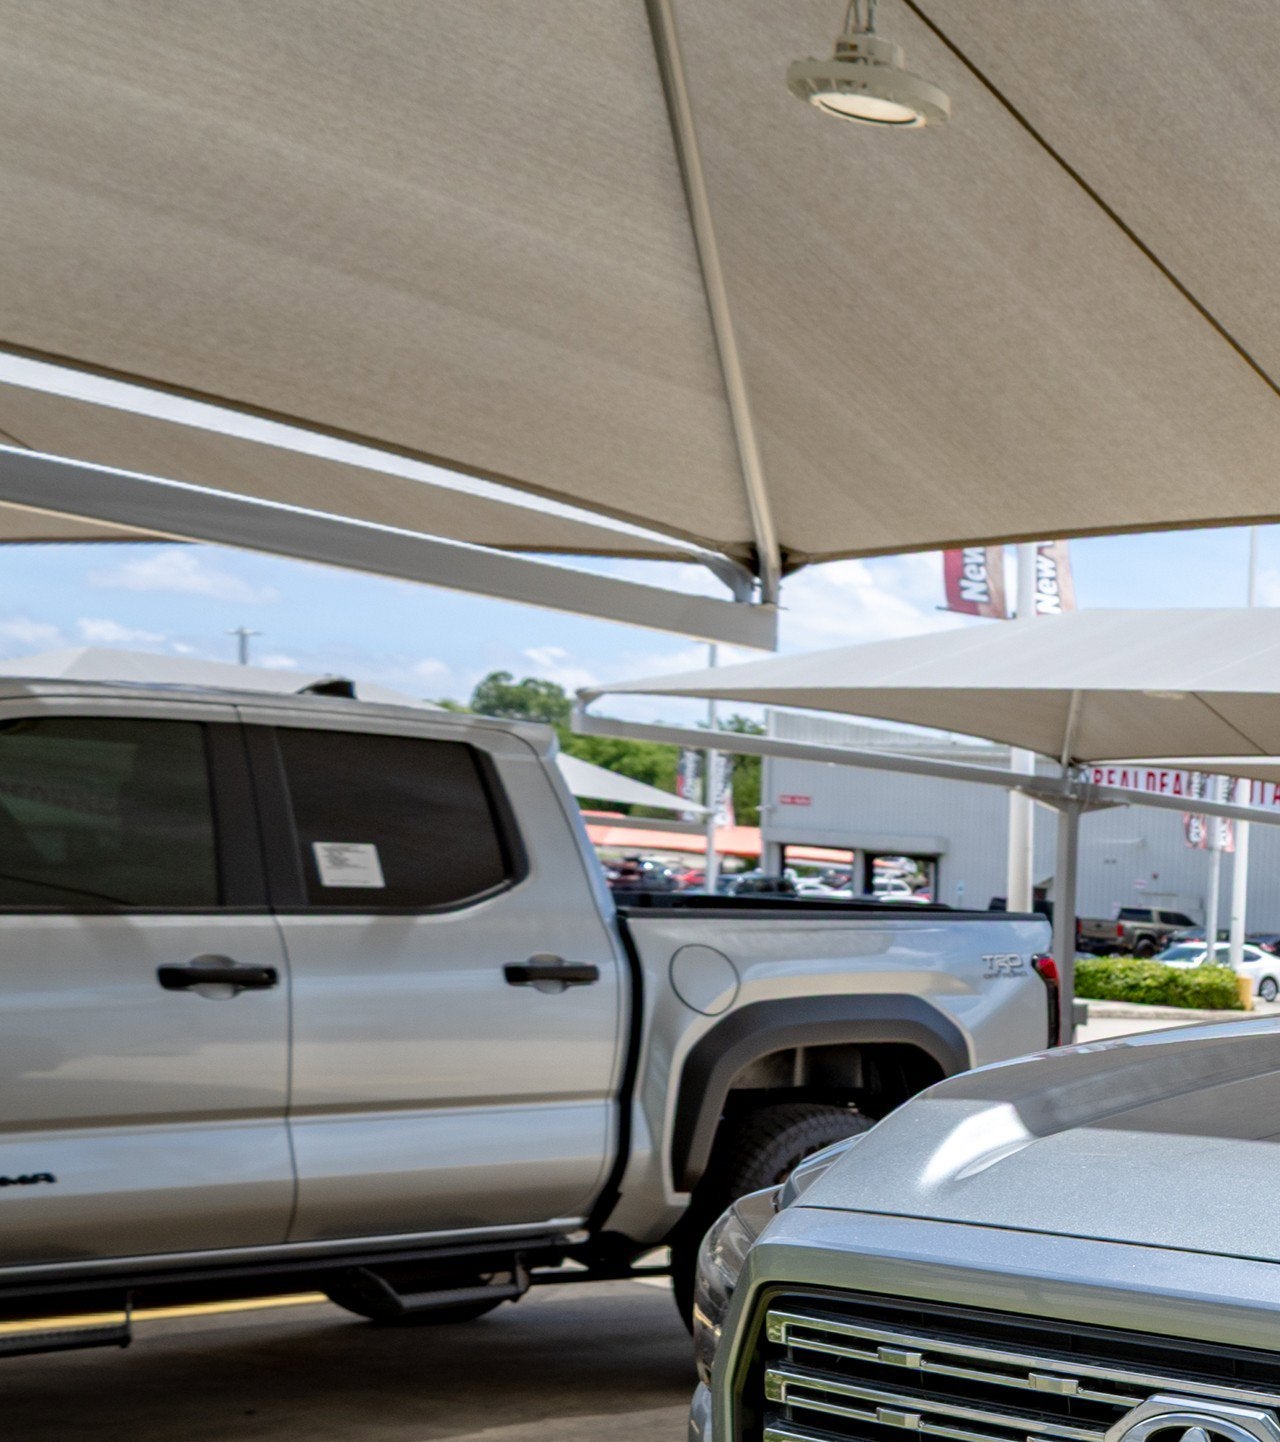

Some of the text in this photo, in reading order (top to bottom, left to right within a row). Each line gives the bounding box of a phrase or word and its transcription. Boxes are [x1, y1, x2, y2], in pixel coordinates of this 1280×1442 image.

[959, 546, 990, 602] New
[1036, 553, 1062, 614] New
[982, 954, 1023, 972] TRD
